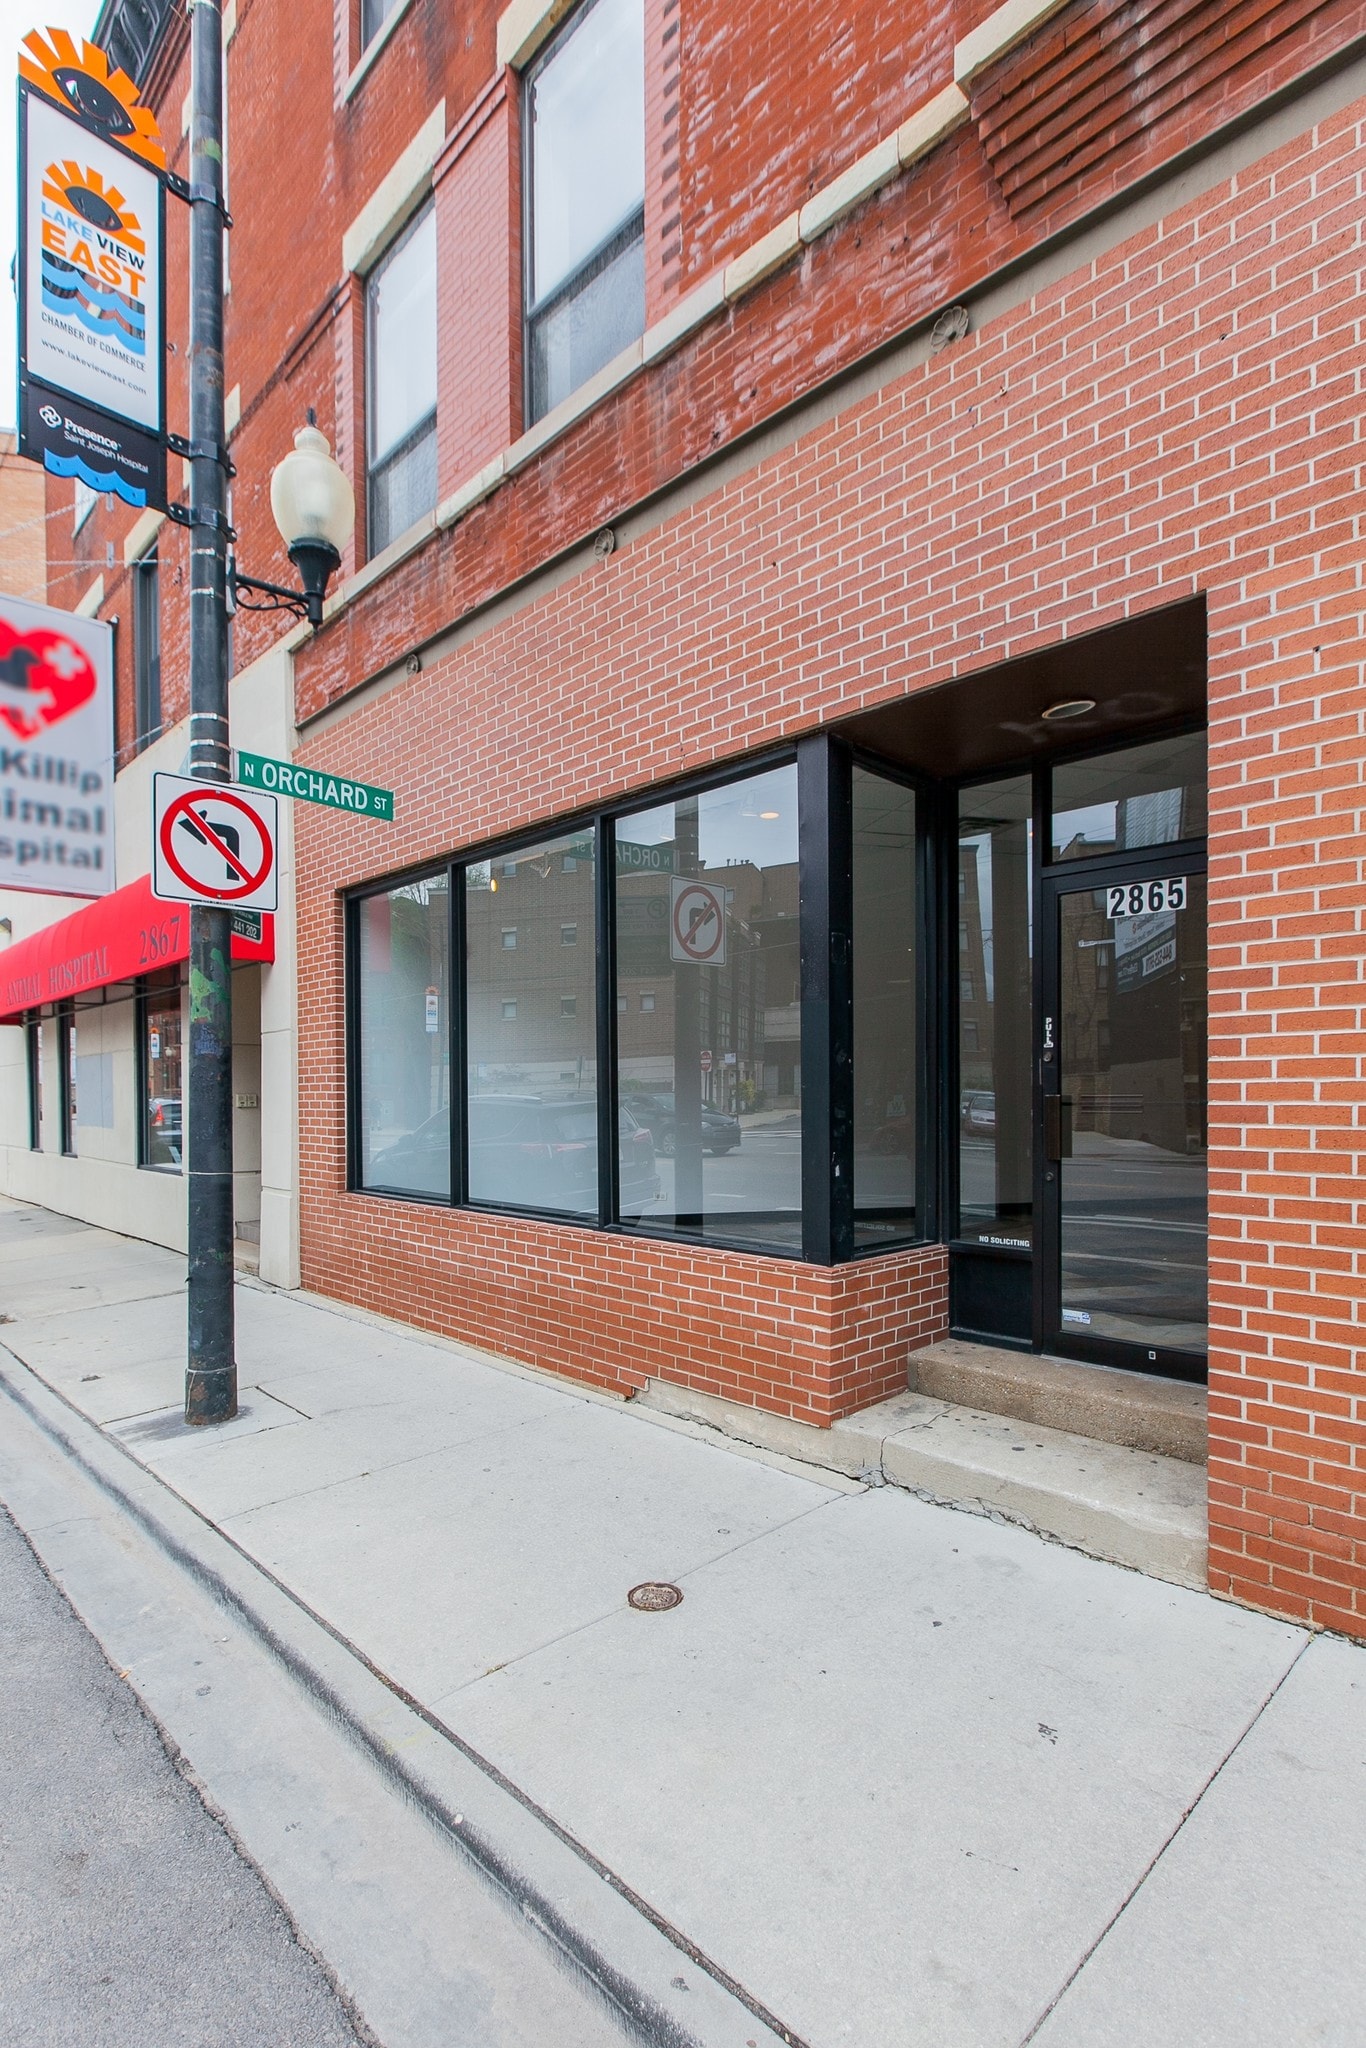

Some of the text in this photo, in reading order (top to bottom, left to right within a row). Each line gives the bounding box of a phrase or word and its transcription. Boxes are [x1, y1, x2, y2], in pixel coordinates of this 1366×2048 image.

[41, 200, 145, 271] LAKE VIEW
[41, 217, 146, 298] EAST
[41, 311, 147, 373] CHAMBER OF COMMERCE
[41, 338, 147, 395] www.lakevieweast.com
[63, 417, 118, 451] Presence
[63, 430, 149, 474] Saint Joseph Hospital
[0, 747, 103, 796] Killip
[244, 762, 255, 778] N
[261, 762, 368, 810] ORCHARD
[373, 796, 388, 811] ST
[0, 787, 106, 834] imal
[0, 835, 104, 871] spital
[1110, 878, 1184, 917] 2865
[139, 915, 181, 965] 2867
[245, 924, 258, 939] 202
[6, 945, 112, 1007] ANIMAL HOSPITAL
[1045, 1017, 1053, 1043] PULL
[978, 1234, 1030, 1248] NO SOLICITING
